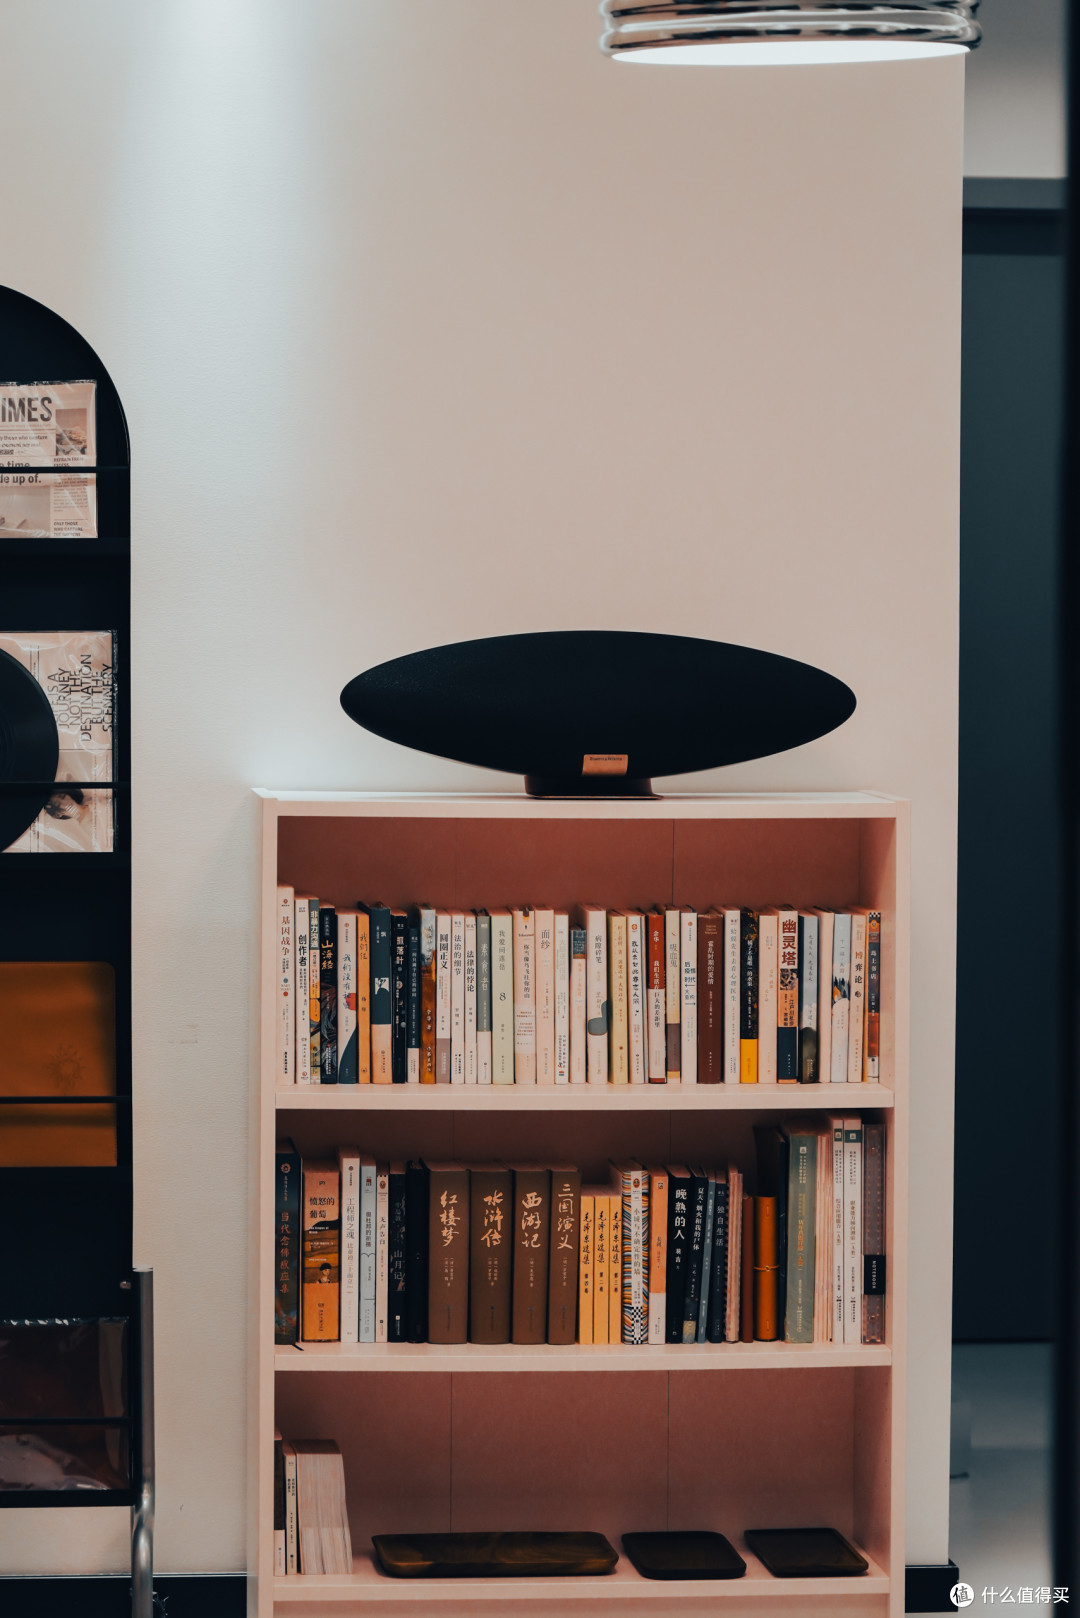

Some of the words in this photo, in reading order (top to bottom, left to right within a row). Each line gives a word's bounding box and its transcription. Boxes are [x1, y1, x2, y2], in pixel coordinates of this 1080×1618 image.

[12, 475, 26, 484] up
[28, 474, 42, 483] of.
[58, 668, 70, 728] JOURNEY
[70, 670, 80, 695] THE
[80, 654, 92, 742] DESTINATION
[70, 698, 80, 726] NOT
[281, 916, 290, 956] 基因战争
[298, 934, 308, 966] 创作者
[360, 932, 368, 960] 我们仨
[439, 933, 449, 970] 圆圈正义
[454, 934, 462, 976] 法治的细节
[540, 930, 550, 950] 面纱
[594, 935, 602, 964] 病隙碎笔
[670, 944, 678, 968] 吸血鬼
[782, 920, 797, 966] 幽灵塔
[466, 950, 474, 993] 法律的悖论
[480, 943, 488, 992] 素食者
[854, 951, 863, 984] 博弈论
[499, 992, 506, 1002] 8
[310, 1196, 336, 1206] 愤怒的
[310, 1210, 327, 1219] 葡萄
[346, 1198, 355, 1240] 工程师之魂
[440, 1190, 460, 1247] 红楼梦
[480, 1190, 504, 1248] 水浒传
[522, 1192, 542, 1248] 西游记
[557, 1184, 574, 1250] 三国演义
[674, 1189, 687, 1240] 晚熟的人
[693, 1188, 704, 1250] 夏天、烟火和我的尸体
[716, 1205, 724, 1247] 独自生活
[280, 1212, 290, 1294] 当代念佛感应集
[394, 1250, 402, 1280] 山月记
